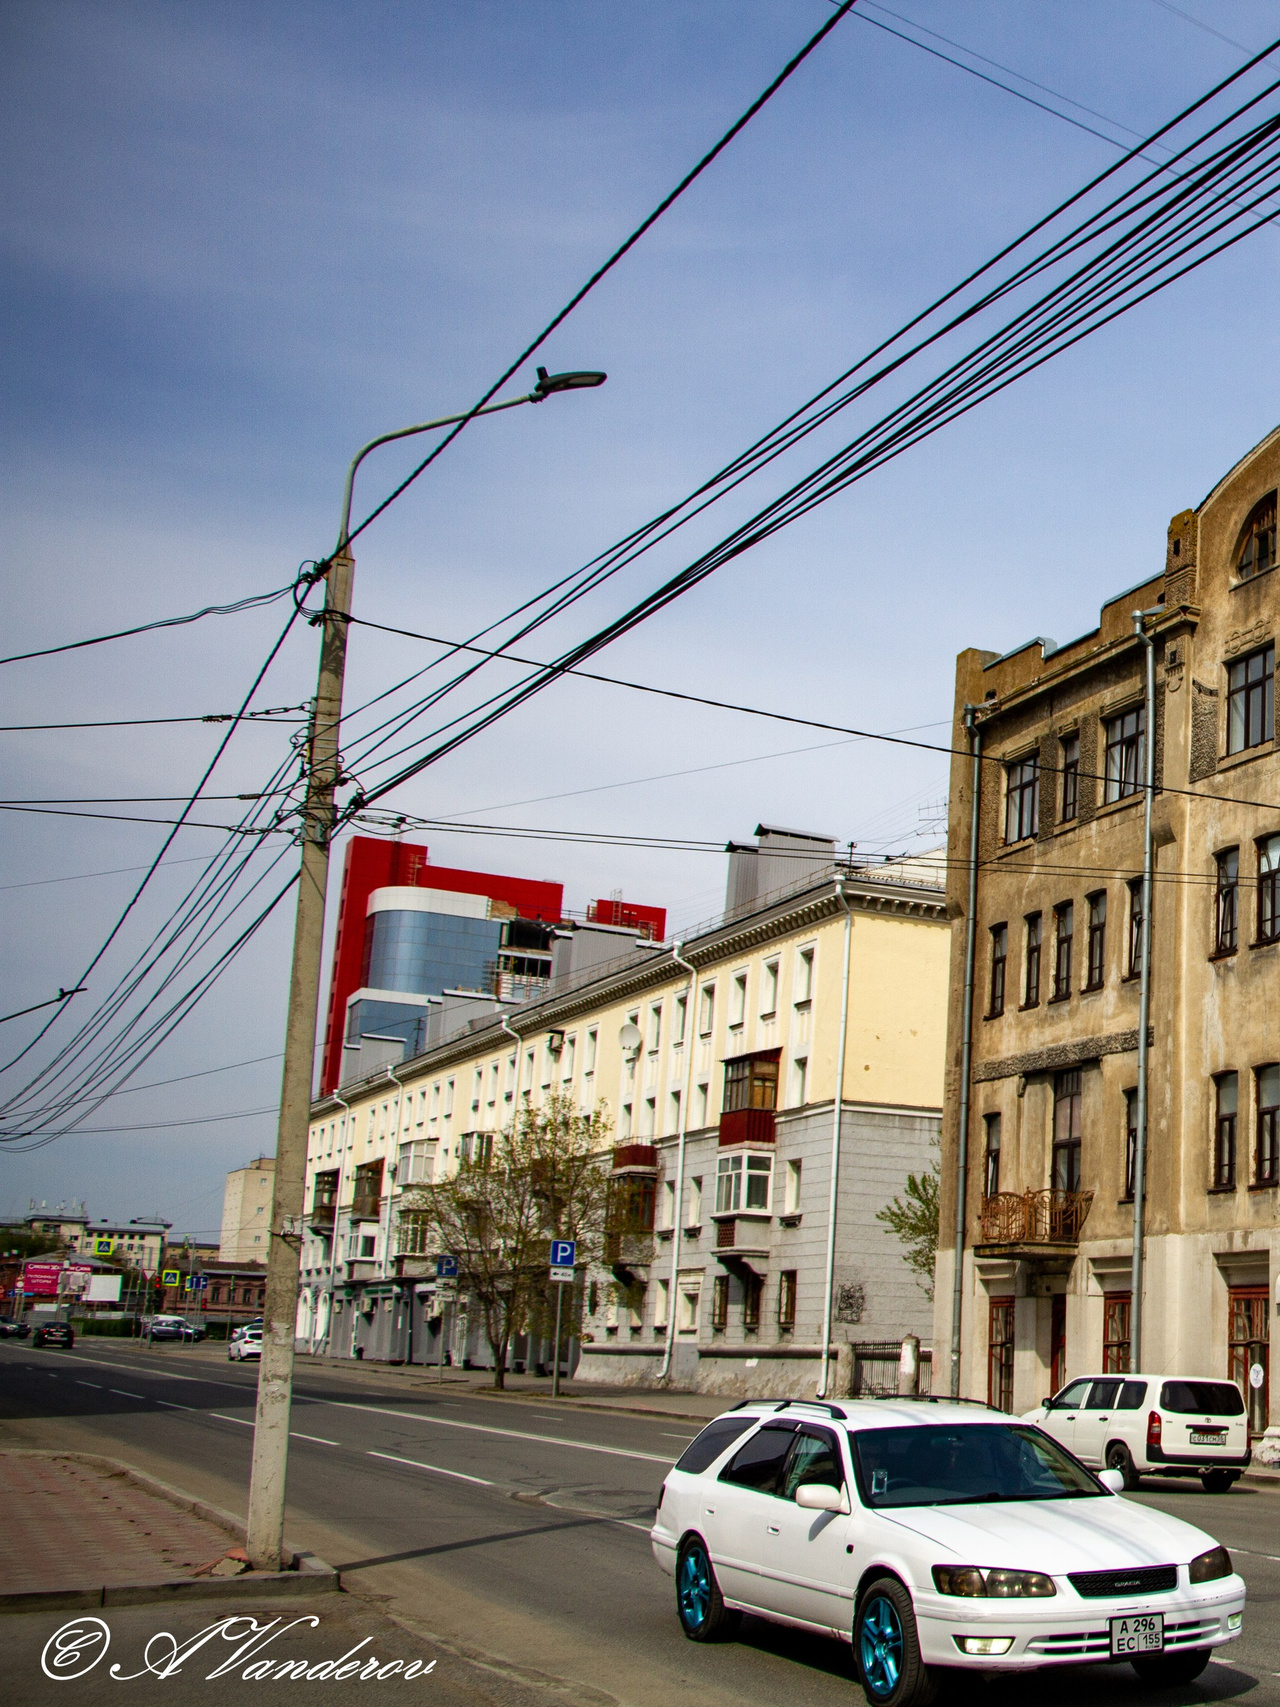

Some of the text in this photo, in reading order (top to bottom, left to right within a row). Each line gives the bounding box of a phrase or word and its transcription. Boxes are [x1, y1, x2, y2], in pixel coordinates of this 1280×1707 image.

[556, 1243, 571, 1262] P
[442, 1257, 455, 1274] P
[1120, 1617, 1156, 1634] А 296
[1117, 1633, 1160, 1652] ЕС 155
